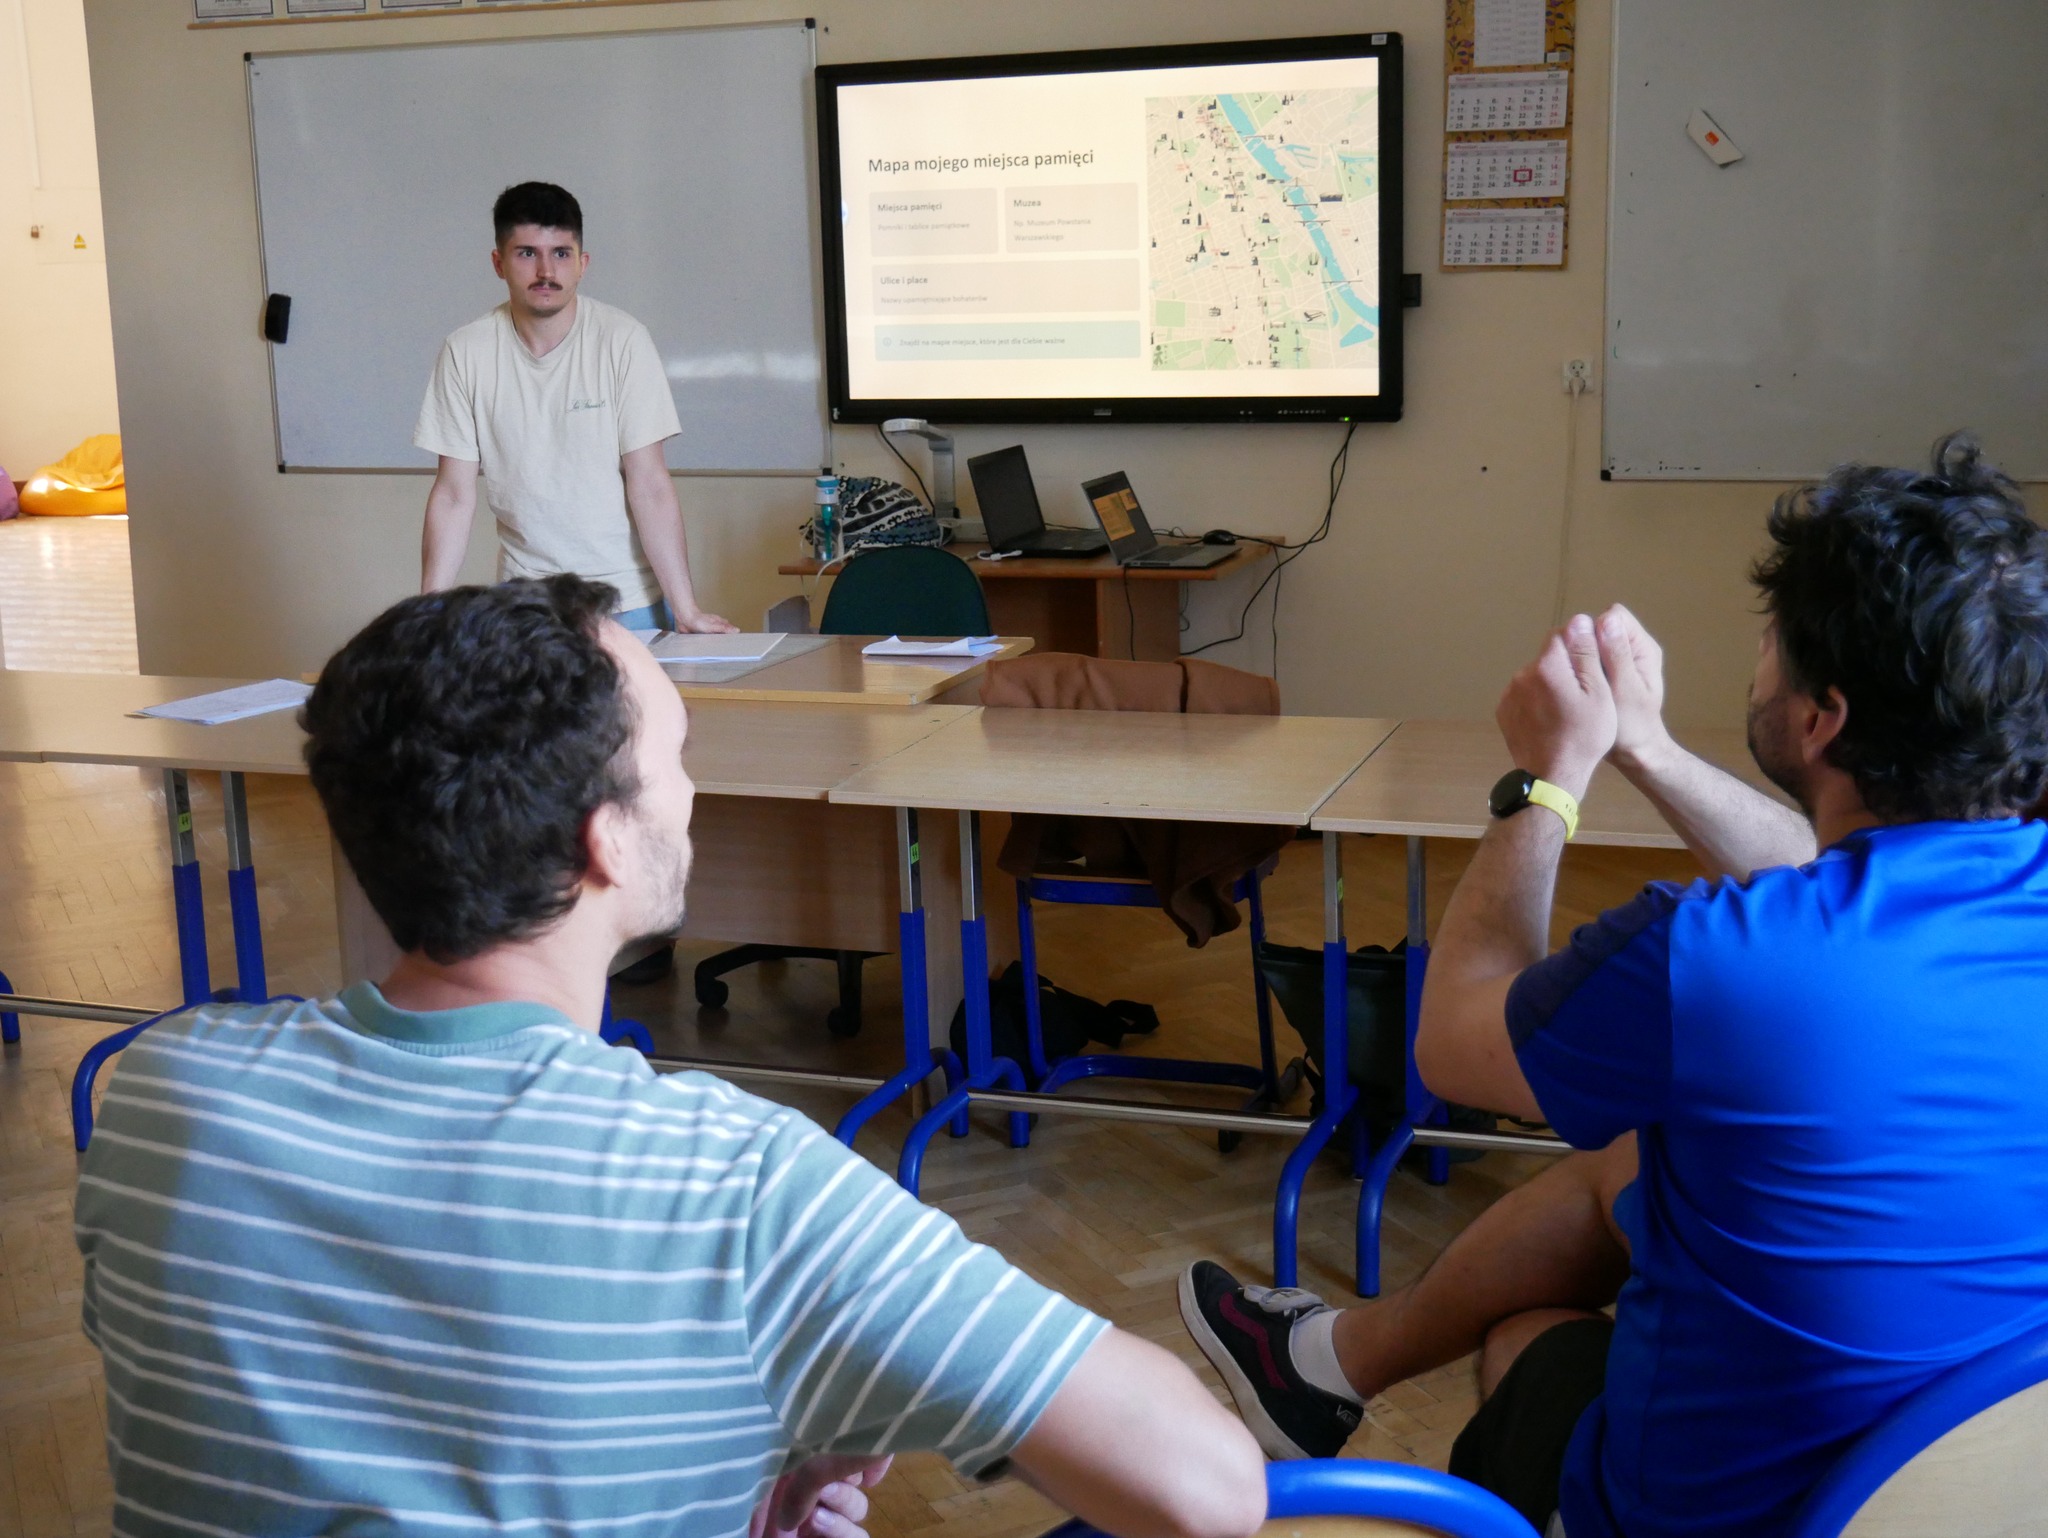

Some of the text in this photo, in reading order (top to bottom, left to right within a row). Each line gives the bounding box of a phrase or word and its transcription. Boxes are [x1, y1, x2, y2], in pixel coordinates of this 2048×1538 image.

[868, 150, 1094, 174] Mapa mojego miejsca pamięci
[878, 202, 942, 213] Miejsca pamięci
[880, 276, 900, 285] Ulice
[907, 275, 928, 286] place
